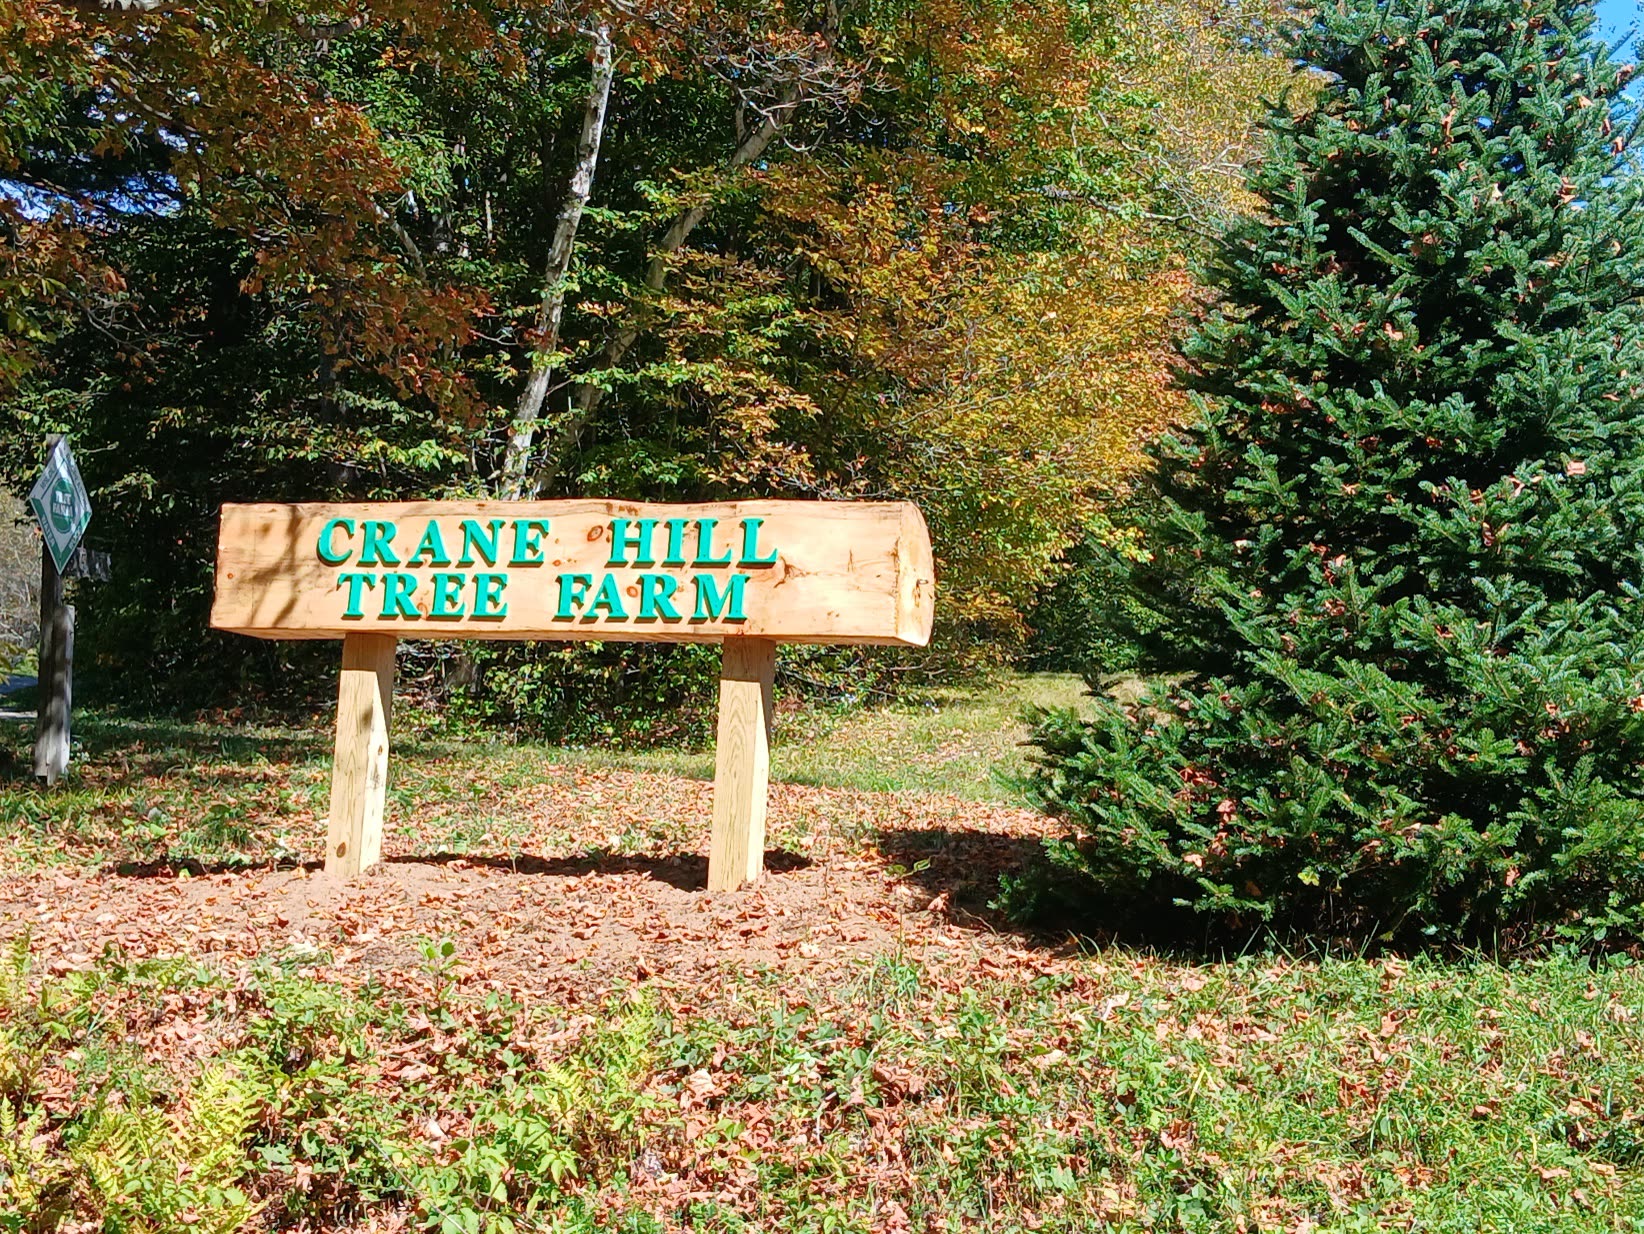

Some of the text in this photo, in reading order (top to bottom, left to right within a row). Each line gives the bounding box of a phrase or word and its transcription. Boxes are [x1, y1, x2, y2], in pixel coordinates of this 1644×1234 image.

[317, 517, 779, 568] CRANE HILL
[337, 572, 750, 622] TREE FARM
